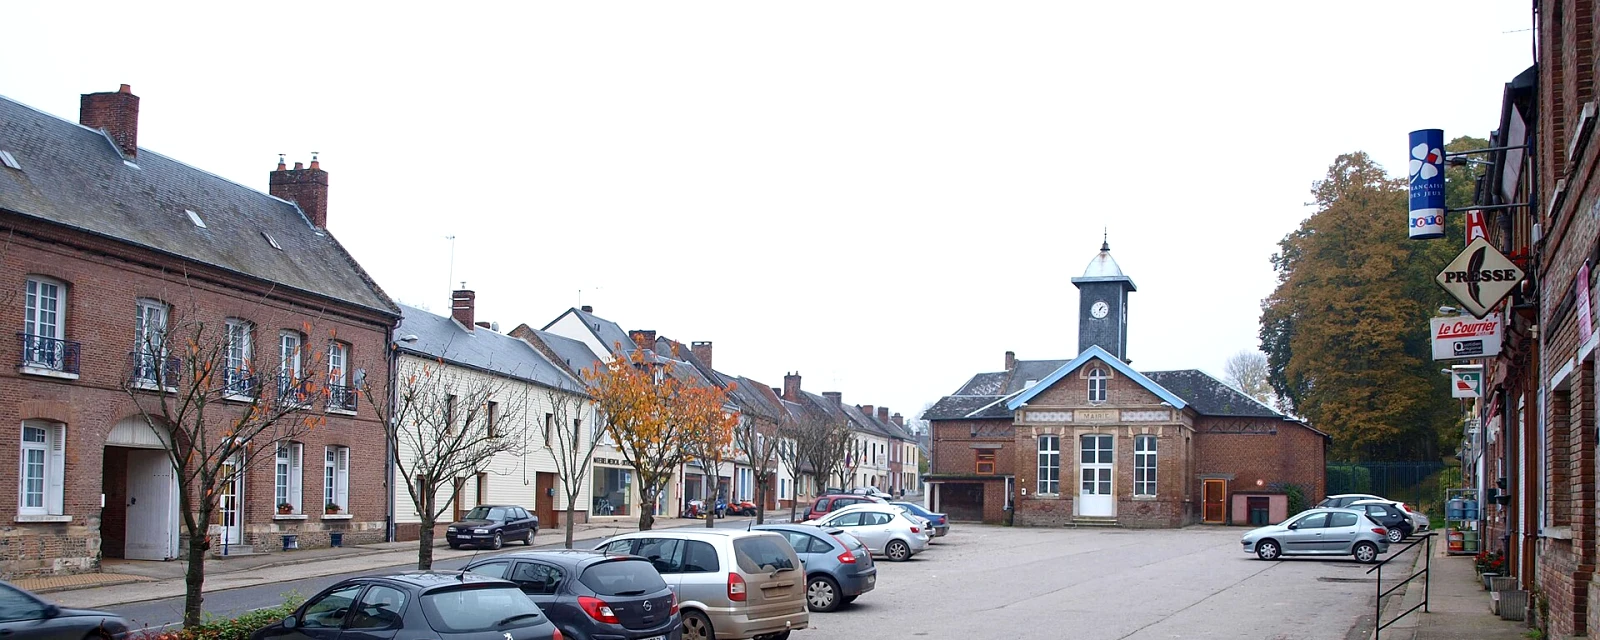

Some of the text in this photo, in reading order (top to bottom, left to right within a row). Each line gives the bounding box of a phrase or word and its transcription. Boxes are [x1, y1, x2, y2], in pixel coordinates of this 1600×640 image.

[1410, 214, 1444, 228] LOTO
[1444, 269, 1517, 283] PRESSE
[1438, 319, 1498, 335] Le Courrier
